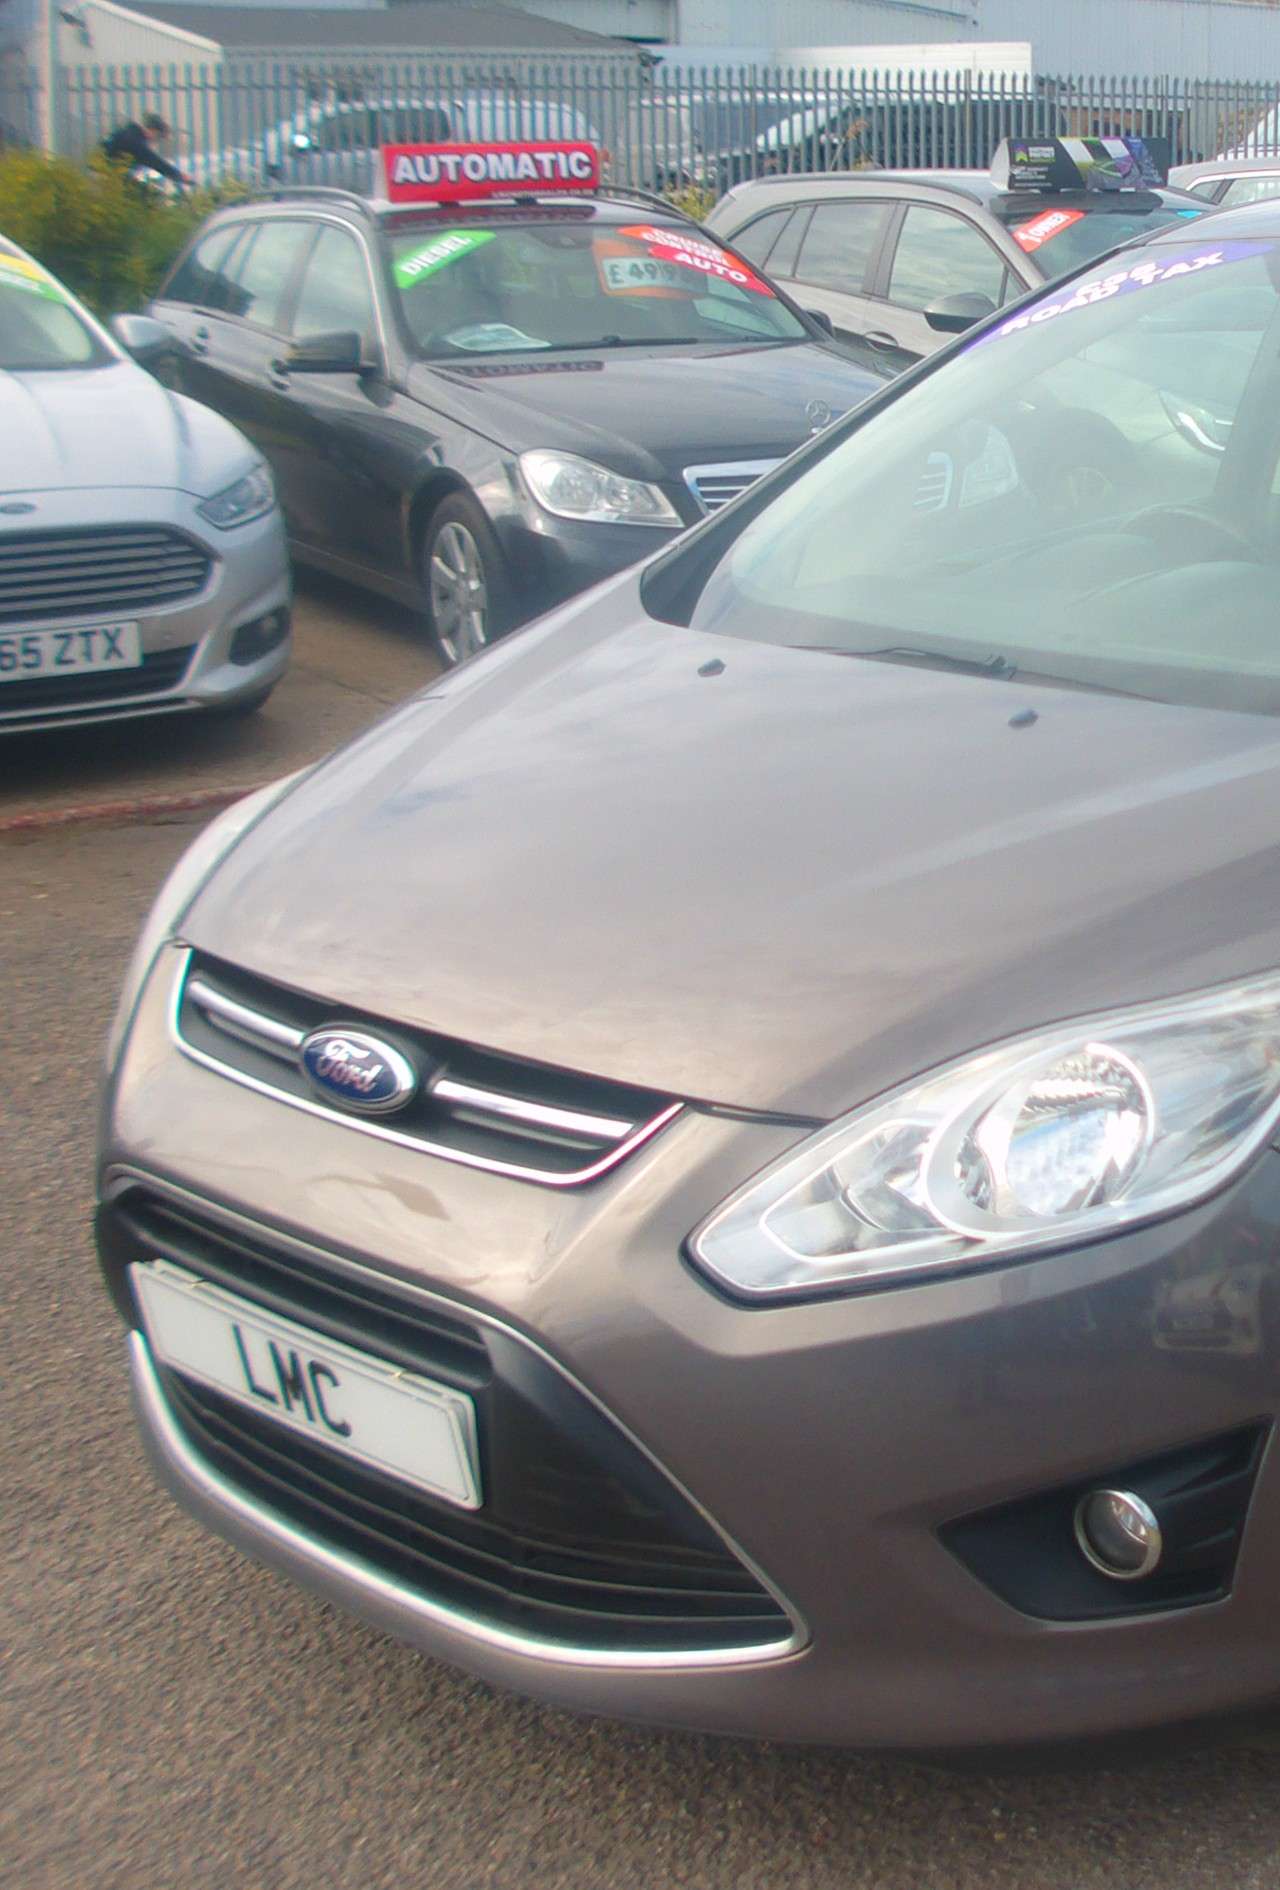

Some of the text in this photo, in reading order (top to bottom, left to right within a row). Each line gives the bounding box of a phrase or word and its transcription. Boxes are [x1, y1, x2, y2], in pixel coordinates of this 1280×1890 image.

[393, 151, 593, 184] AUTOMATIC
[400, 235, 472, 276] DIESEL
[674, 252, 748, 283] AUTO
[1000, 252, 1224, 336] ROAD TAX
[53, 627, 124, 666] ZTX
[316, 1040, 384, 1093] Ford
[233, 1323, 352, 1438] LMC
